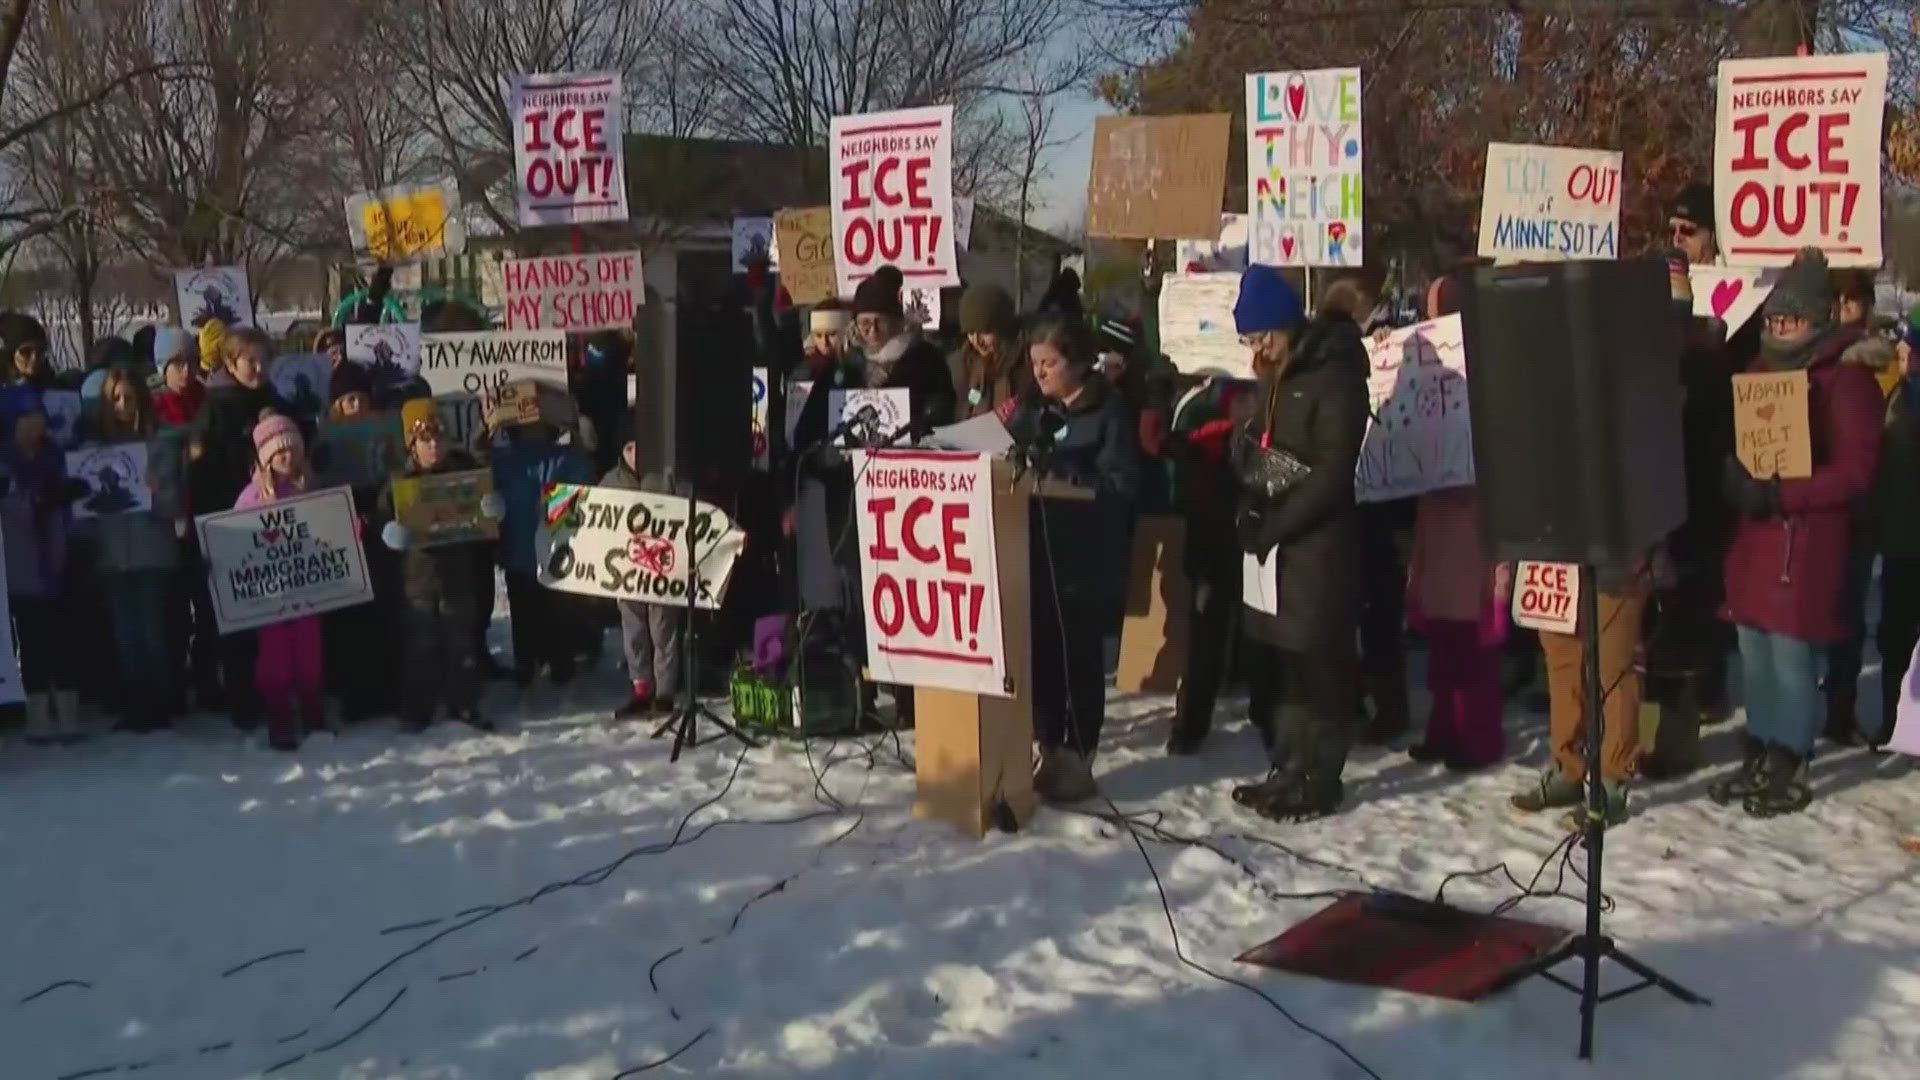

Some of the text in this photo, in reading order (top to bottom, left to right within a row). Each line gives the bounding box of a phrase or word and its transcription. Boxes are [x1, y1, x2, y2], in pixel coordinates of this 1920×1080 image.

[523, 92, 610, 108] NEIGHBORS SAY
[1256, 73, 1359, 122] LOVE
[1733, 88, 1861, 110] NEIGHBORS SAY
[525, 109, 607, 152] ICE
[841, 135, 939, 158] NEIGHBORS SAY
[1255, 123, 1350, 167] THY
[1731, 112, 1850, 174] ICE
[526, 157, 613, 199] OUT!
[841, 157, 933, 210] ICE
[1567, 164, 1618, 205] OUT
[1730, 180, 1860, 242] OUT!
[844, 216, 942, 266] OUT!
[1493, 213, 1615, 256] MINNESOTA
[505, 255, 635, 293] HANDS OFF
[507, 290, 634, 331] MY SCHOOL
[420, 341, 464, 369] TAY
[1742, 424, 1792, 450] MELT
[1753, 448, 1788, 473] ICE
[867, 469, 977, 493] NEIGHBORS SAY
[260, 507, 296, 529] WE
[627, 503, 684, 540] OUT
[867, 497, 972, 575] ICE
[229, 547, 347, 584] IMMIGRANT
[266, 541, 302, 560] OUR
[550, 544, 712, 600] OUR SCHOOS
[1525, 564, 1568, 592] ICE
[873, 574, 985, 651] OUT!
[1521, 589, 1571, 618] OUT!
